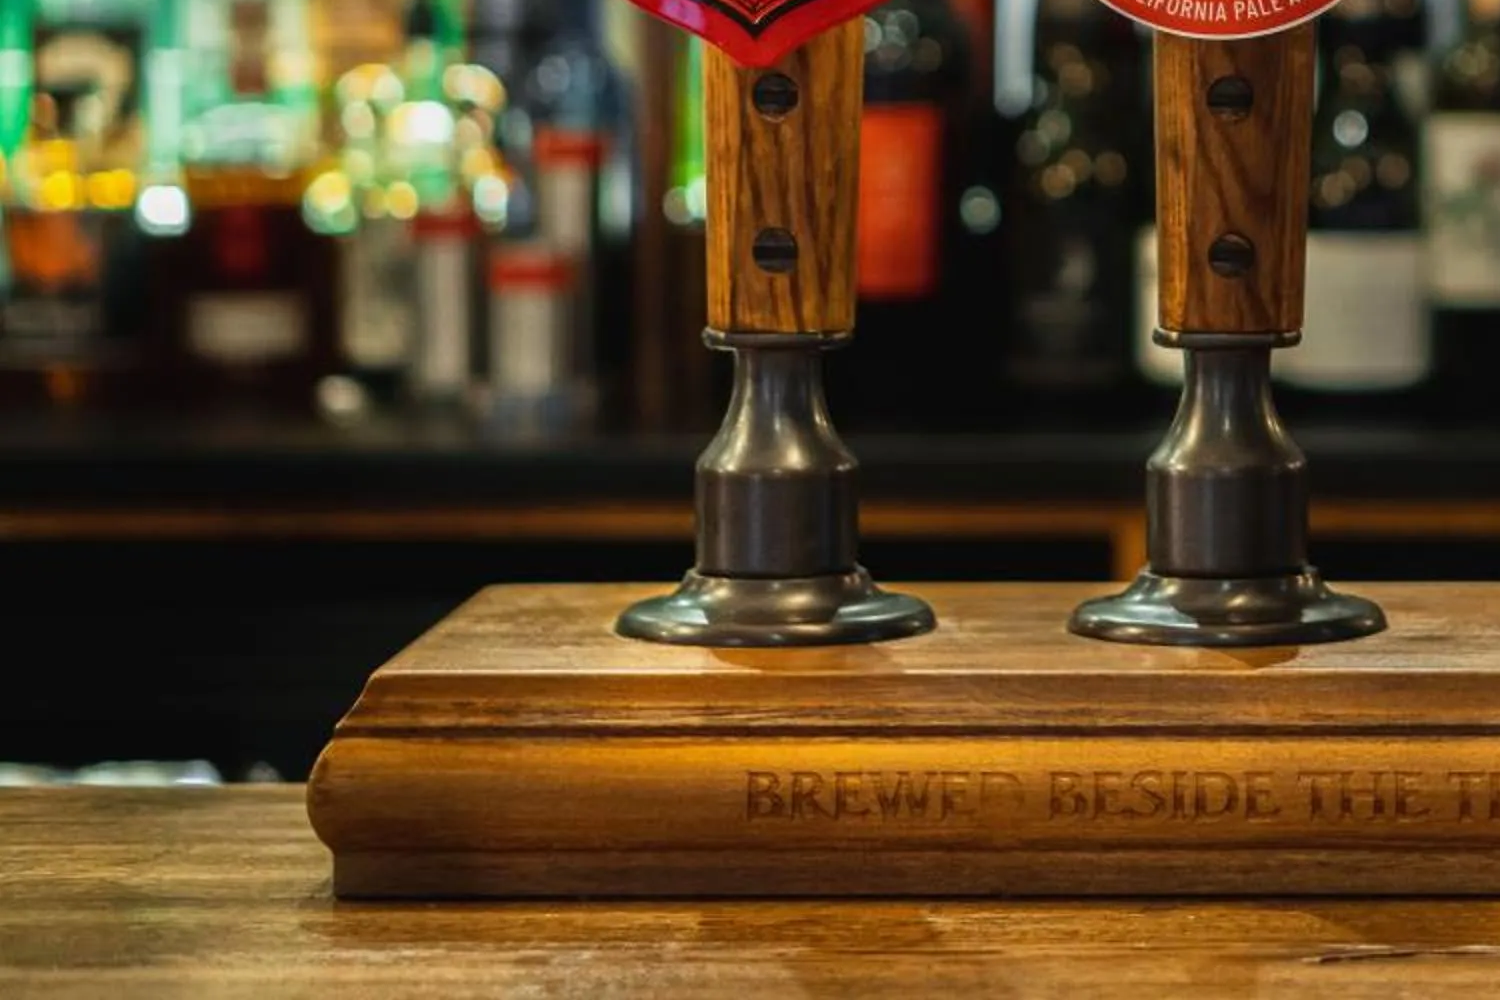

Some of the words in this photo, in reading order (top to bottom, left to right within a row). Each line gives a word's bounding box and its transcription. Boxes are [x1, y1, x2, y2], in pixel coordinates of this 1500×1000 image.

[745, 770, 1025, 822] BREWED
[1047, 769, 1283, 822] BESIDE
[1297, 769, 1430, 822] THE
